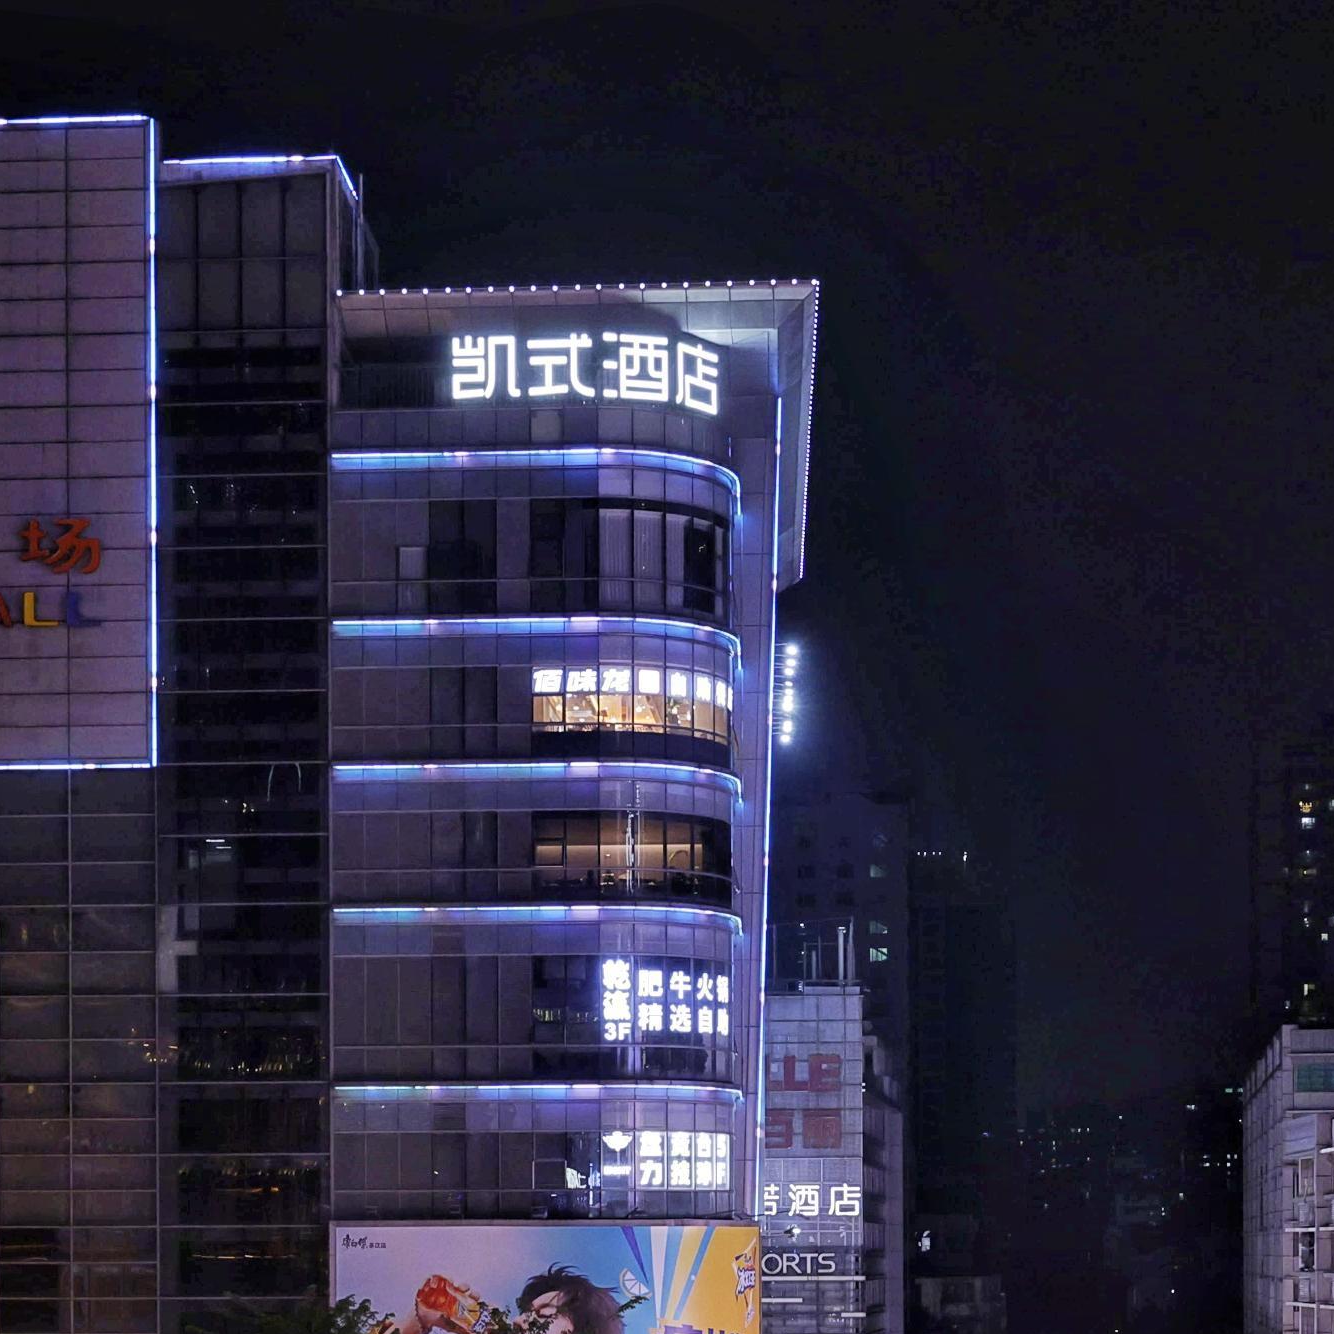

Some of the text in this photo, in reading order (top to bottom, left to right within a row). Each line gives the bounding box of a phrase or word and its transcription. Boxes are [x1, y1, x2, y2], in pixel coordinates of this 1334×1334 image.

[450, 331, 721, 416] 凯式酒店
[604, 1022, 632, 1041] 3F
